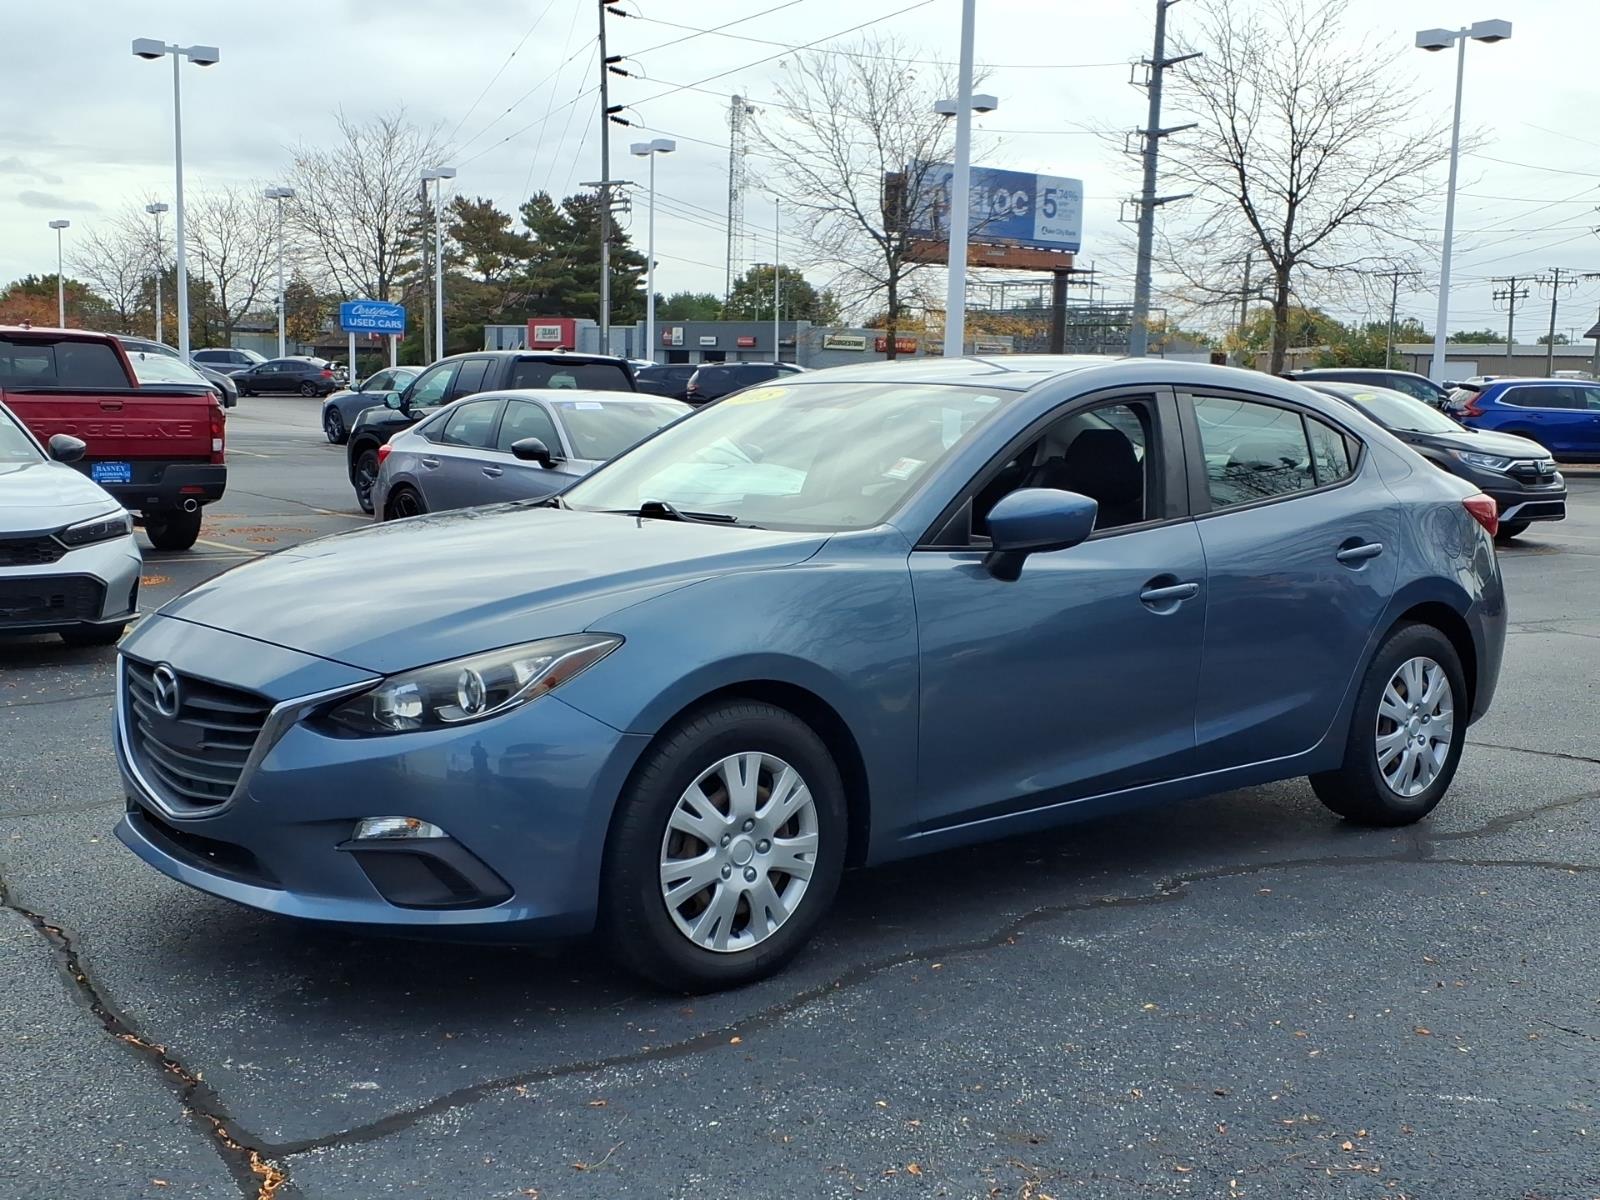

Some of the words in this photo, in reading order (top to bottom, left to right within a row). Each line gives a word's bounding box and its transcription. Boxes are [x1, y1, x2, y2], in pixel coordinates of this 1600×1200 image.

[968, 184, 1029, 217] ELOC
[1042, 188, 1057, 218] 5
[351, 304, 400, 318] Certified
[349, 318, 376, 327] USED
[377, 320, 402, 328] CARS
